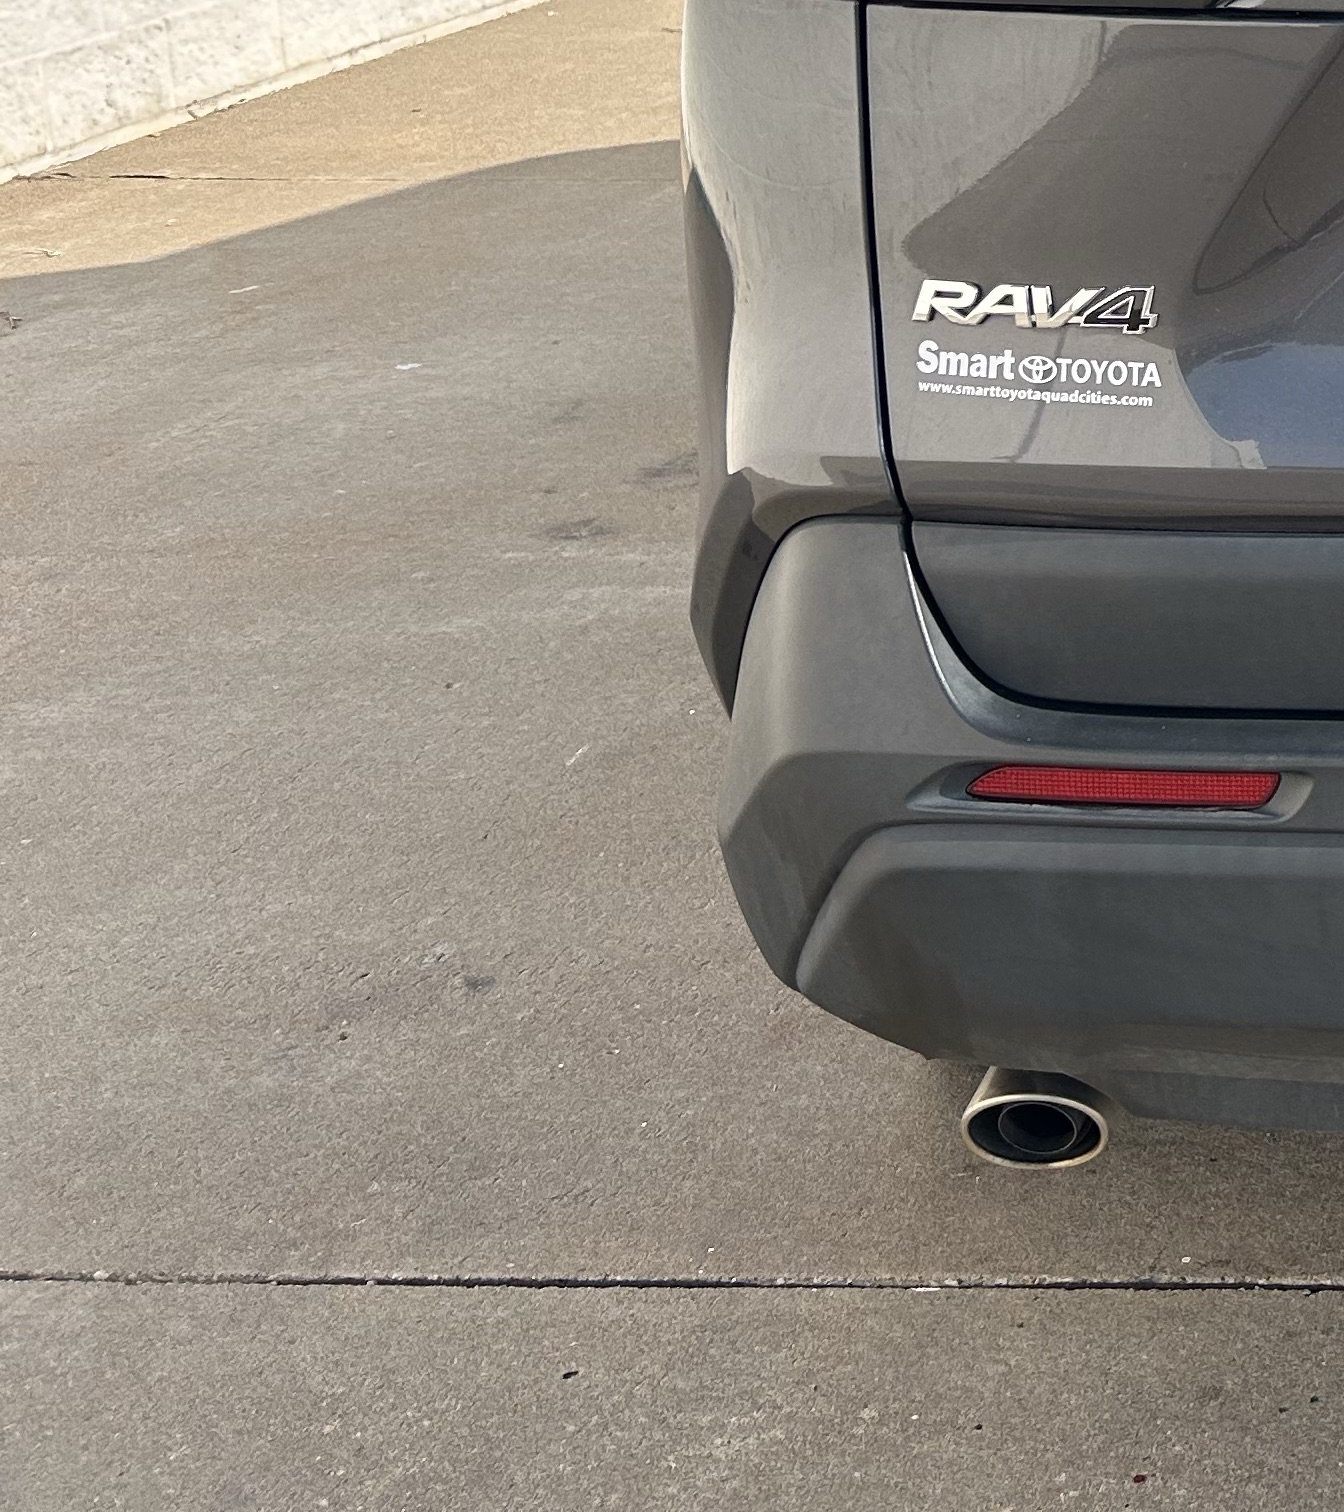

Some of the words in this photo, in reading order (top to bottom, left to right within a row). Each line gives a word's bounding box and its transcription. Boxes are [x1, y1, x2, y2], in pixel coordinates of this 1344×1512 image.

[911, 279, 1160, 336] RAV4
[915, 339, 1016, 381] Smart
[1055, 357, 1163, 388] TOYOTA
[917, 380, 1154, 408] www.smarttoyotaquadcities.com
